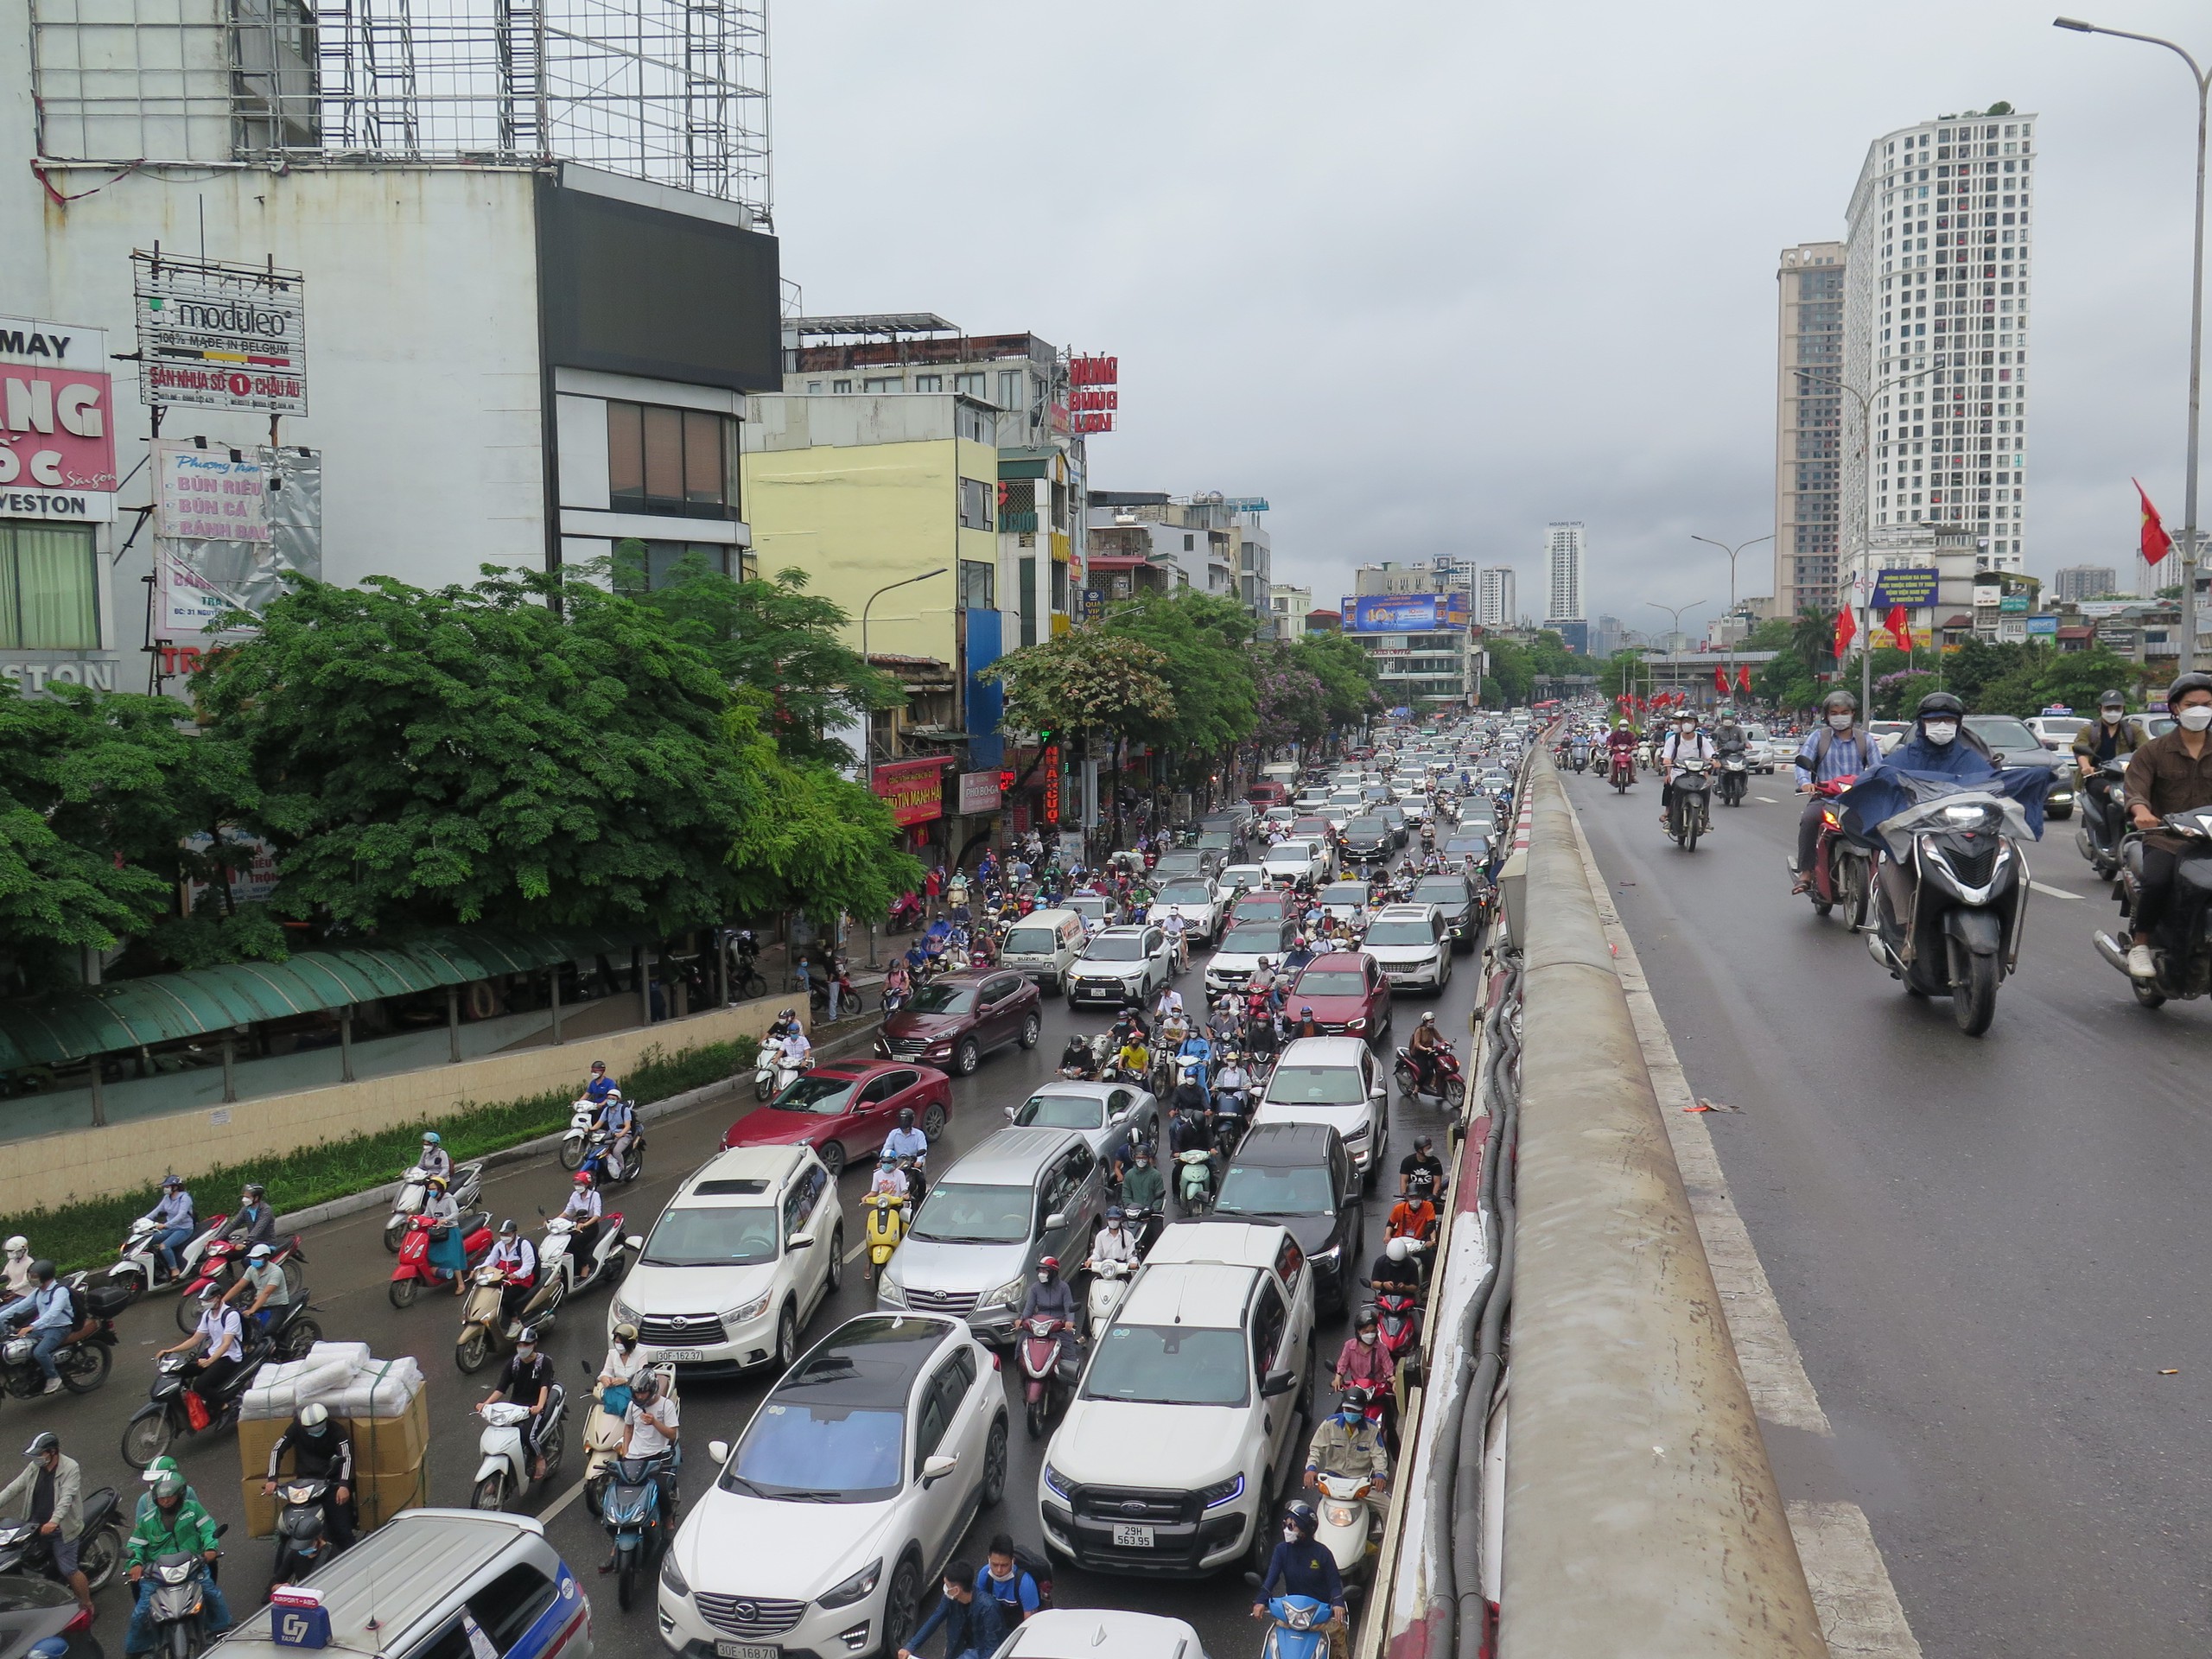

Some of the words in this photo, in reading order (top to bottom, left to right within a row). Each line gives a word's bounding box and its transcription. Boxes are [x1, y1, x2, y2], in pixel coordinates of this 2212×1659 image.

[180, 301, 285, 335] moduleo
[0, 329, 71, 359] MAY
[159, 333, 185, 345] 100%
[189, 335, 223, 349] MADE
[227, 339, 238, 350] IN
[241, 341, 289, 355] BELGIUM
[236, 377, 245, 392] 1
[1074, 412, 1112, 433] LAN
[1124, 1526, 1143, 1536] 29H
[283, 1613, 309, 1643] G7
